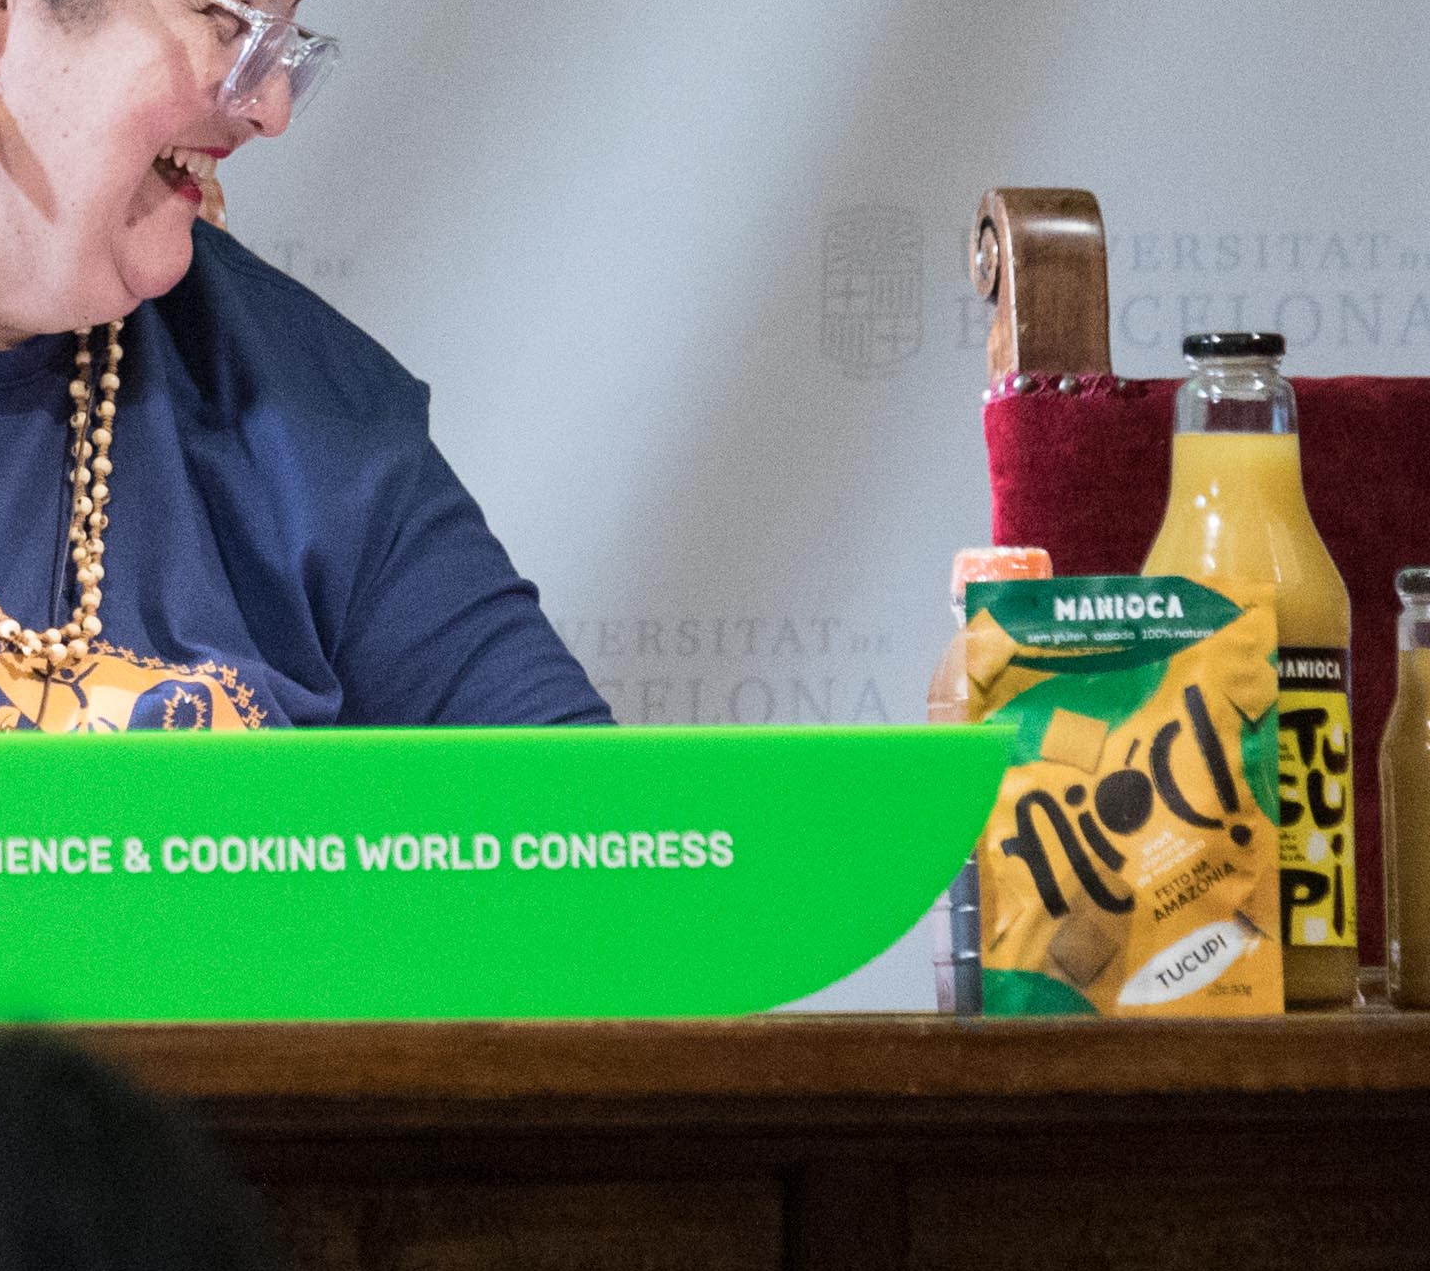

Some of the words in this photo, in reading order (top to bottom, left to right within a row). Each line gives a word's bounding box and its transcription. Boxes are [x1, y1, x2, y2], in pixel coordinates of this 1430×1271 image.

[1053, 593, 1185, 622] MANIOCA
[1093, 630, 1136, 642] assado
[1142, 628, 1173, 640] 100%
[123, 837, 152, 874] &
[162, 835, 347, 874] COOKING
[356, 834, 502, 872] WORLD
[512, 831, 735, 870] CONGRESS
[1154, 872, 1192, 900] FEITO
[1155, 933, 1229, 989] TUCUPI
